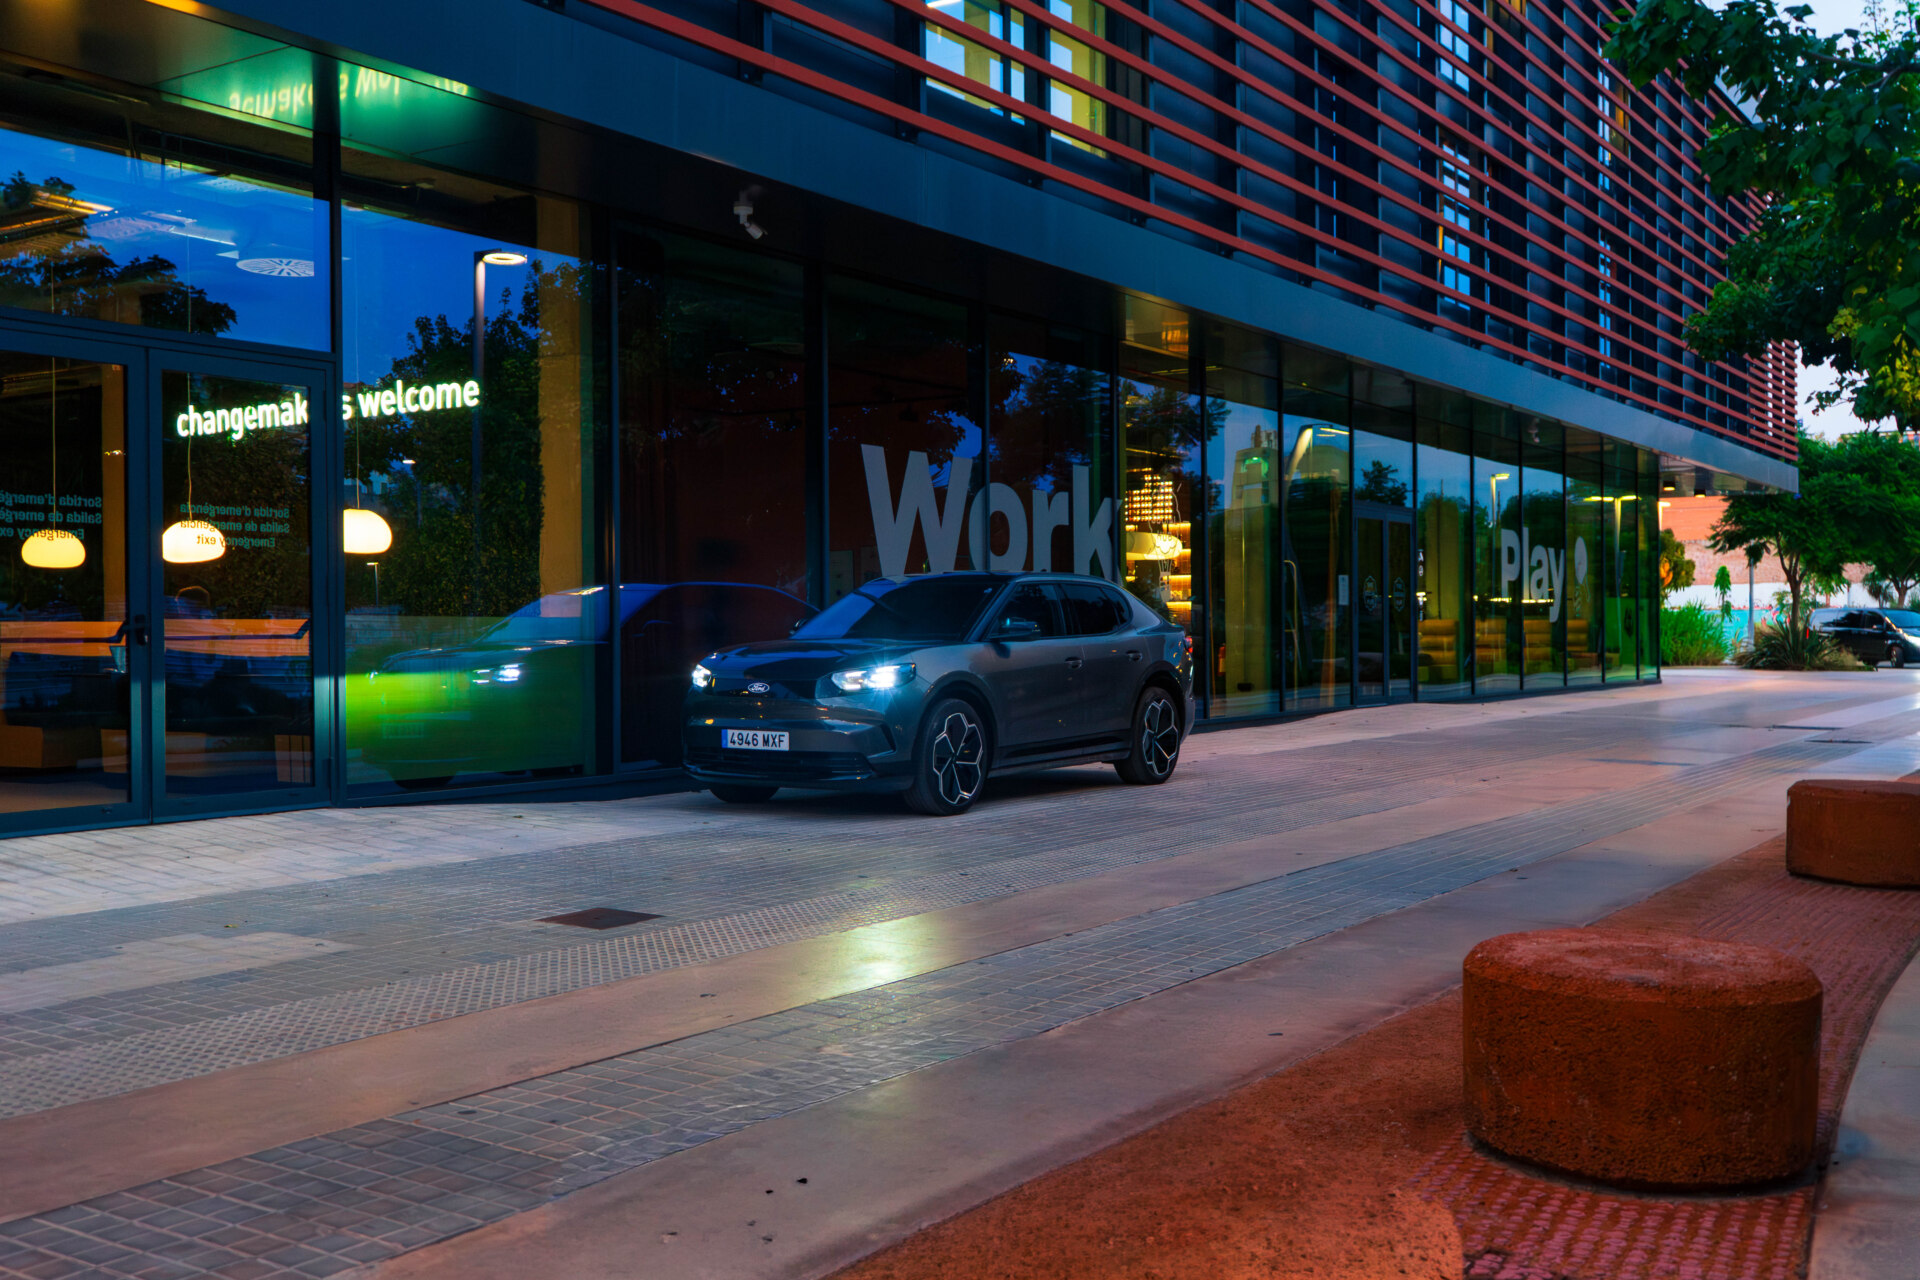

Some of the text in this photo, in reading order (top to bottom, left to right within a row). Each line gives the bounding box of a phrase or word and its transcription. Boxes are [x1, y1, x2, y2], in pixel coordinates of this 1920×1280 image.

[176, 379, 480, 440] changemaks welcome
[861, 443, 1124, 588] Work
[1501, 526, 1565, 623] Play
[729, 732, 785, 748] 4946 MXF
